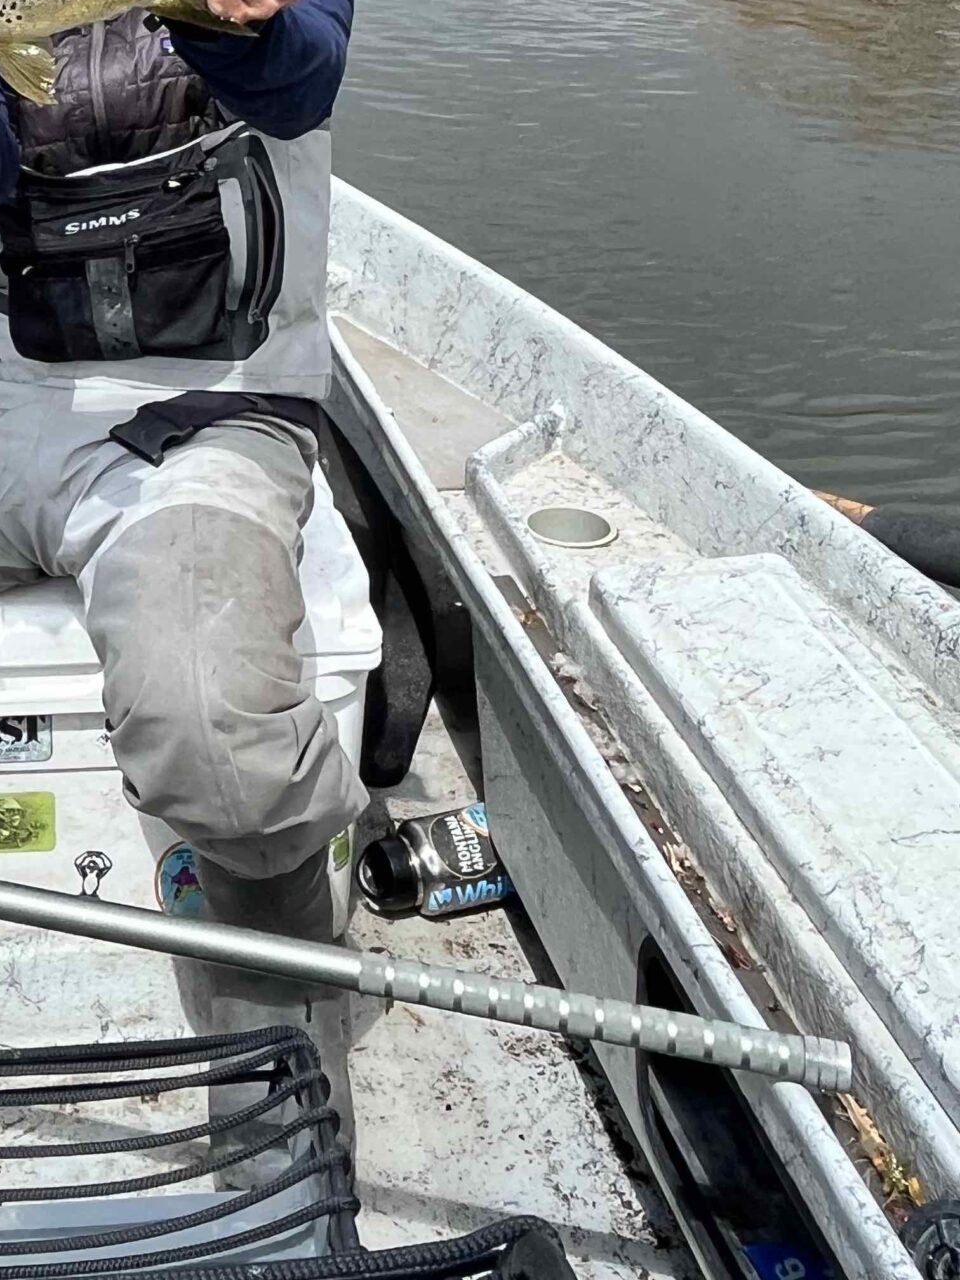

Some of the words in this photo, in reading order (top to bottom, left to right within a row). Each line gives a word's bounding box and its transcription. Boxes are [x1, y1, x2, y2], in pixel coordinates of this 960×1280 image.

[64, 208, 141, 235] SIMMS
[444, 815, 473, 873] MONTANA
[459, 822, 485, 872] ANGLIN
